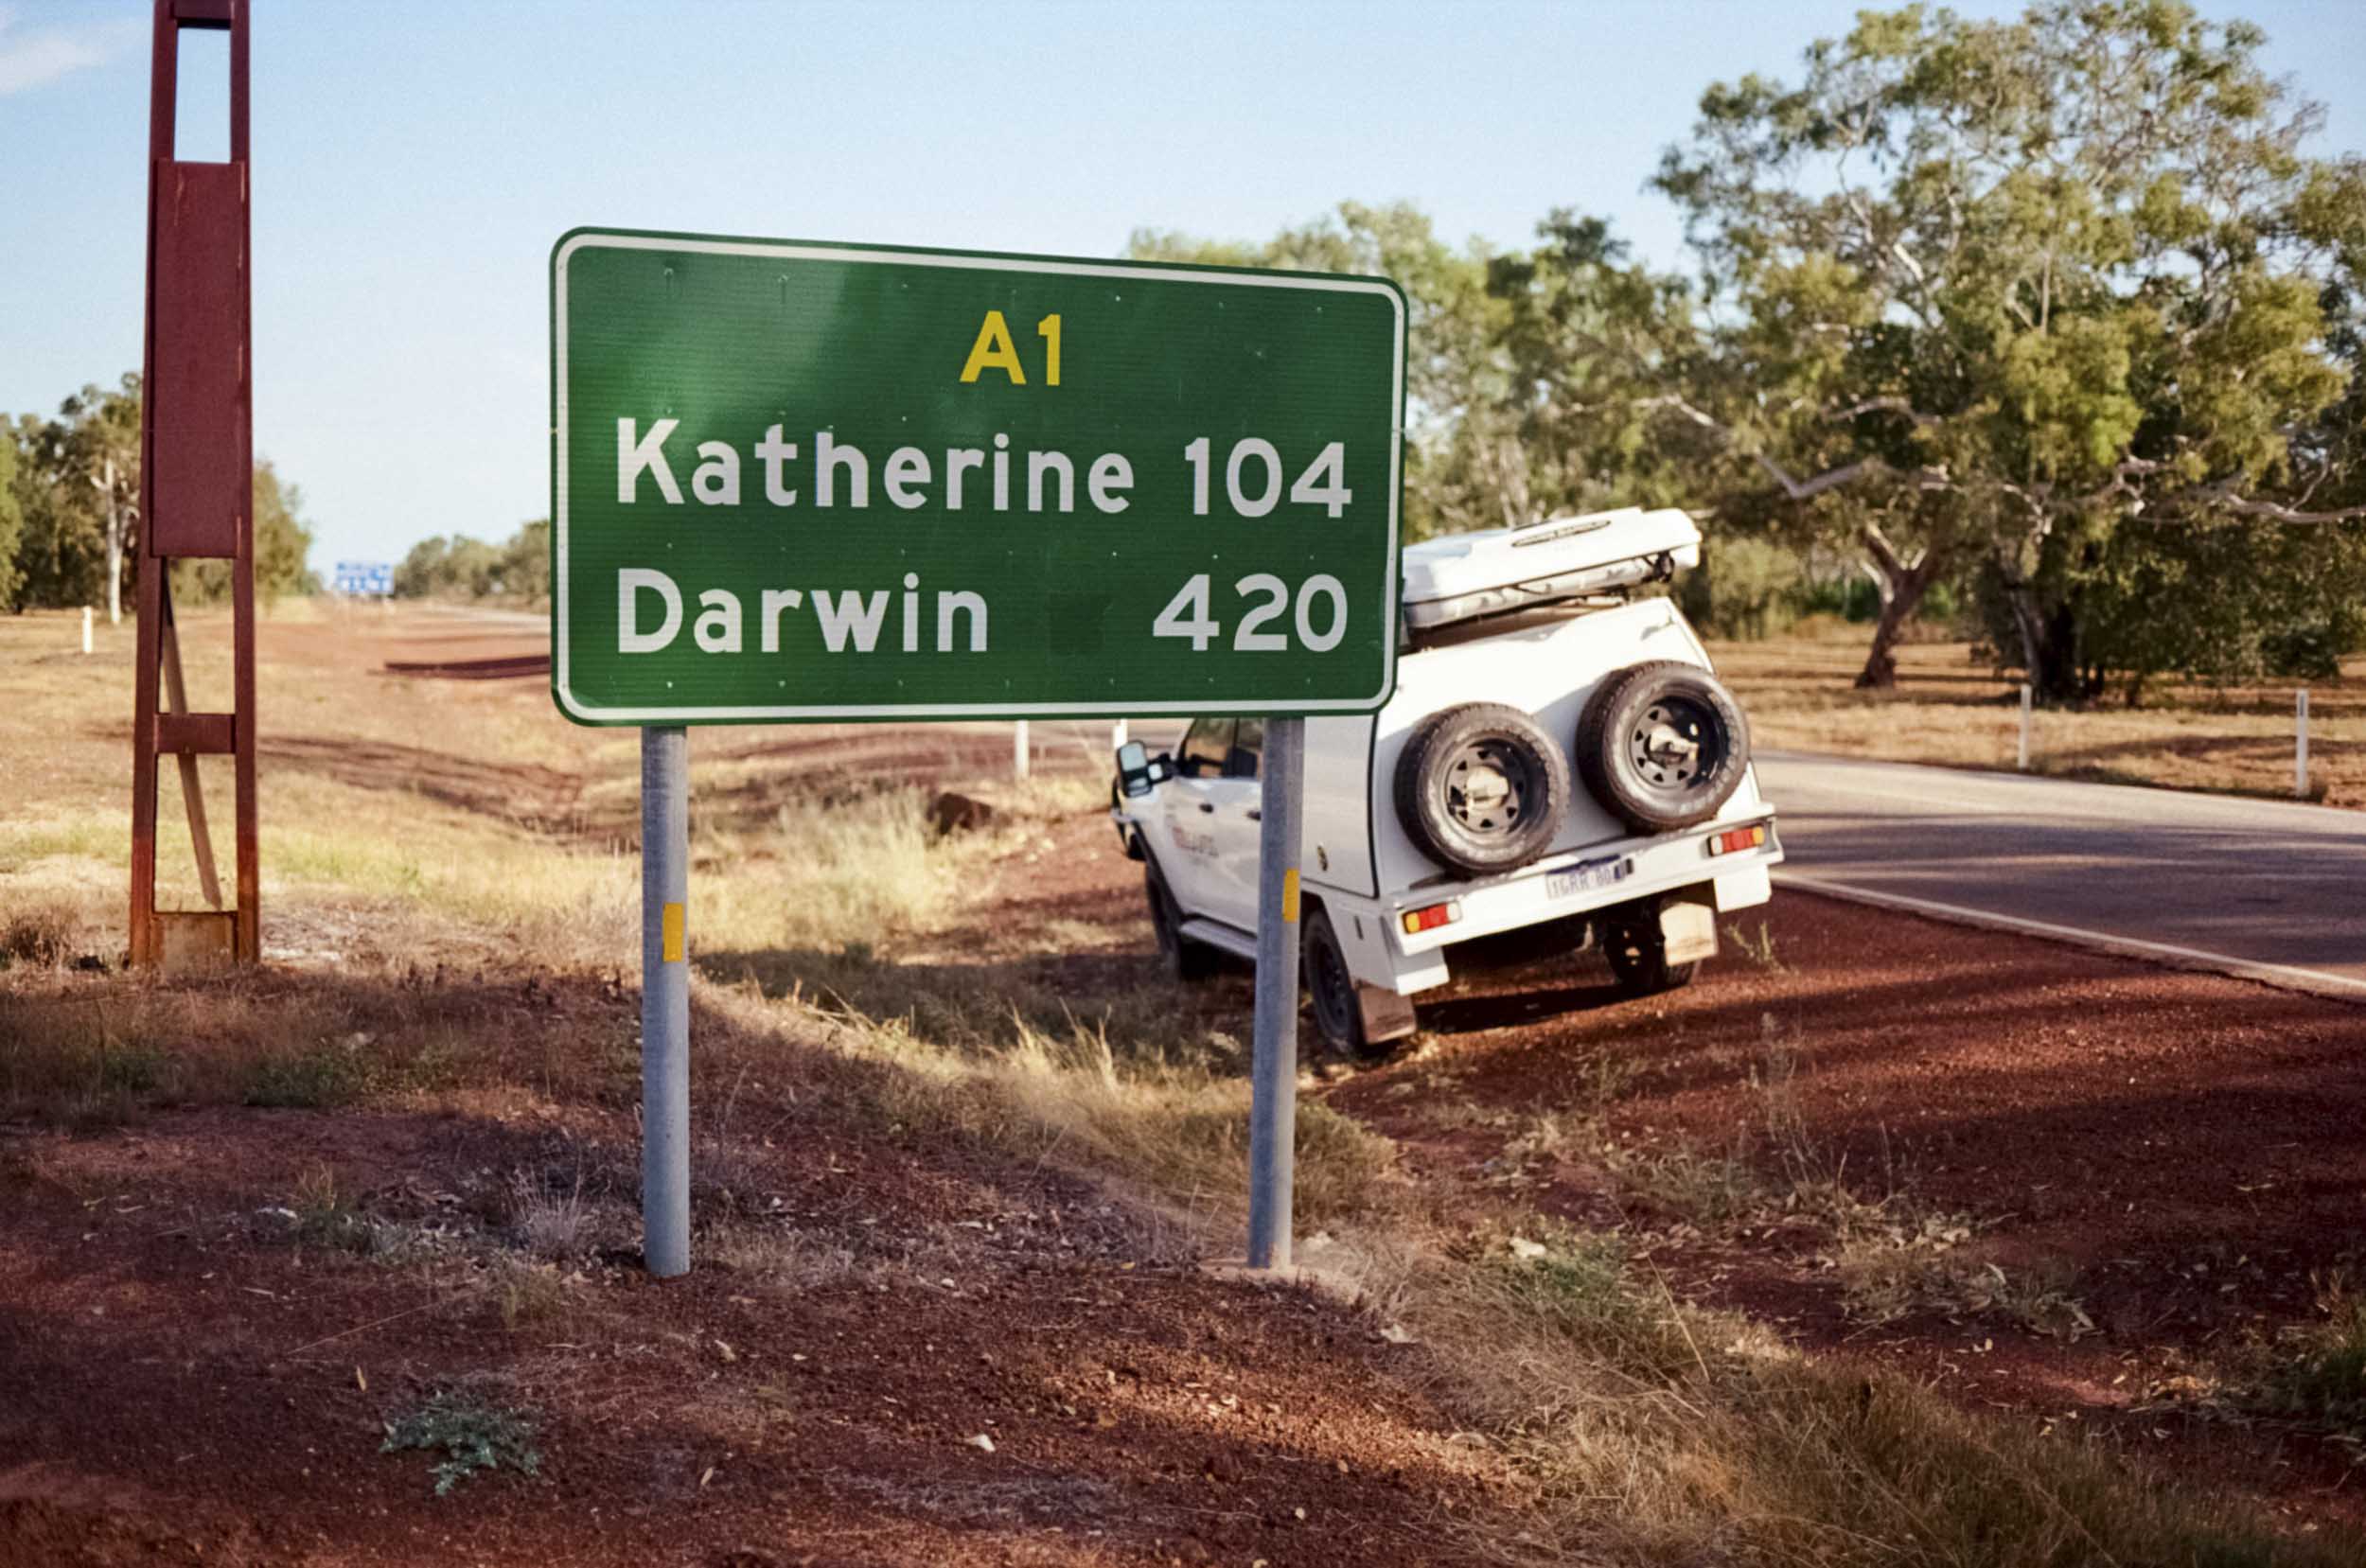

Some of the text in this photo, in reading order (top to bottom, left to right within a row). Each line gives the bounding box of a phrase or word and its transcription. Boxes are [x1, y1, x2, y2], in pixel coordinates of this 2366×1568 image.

[960, 310, 1062, 386] A1
[617, 416, 1352, 518] Katherine 104
[618, 568, 1349, 654] Darwin 420
